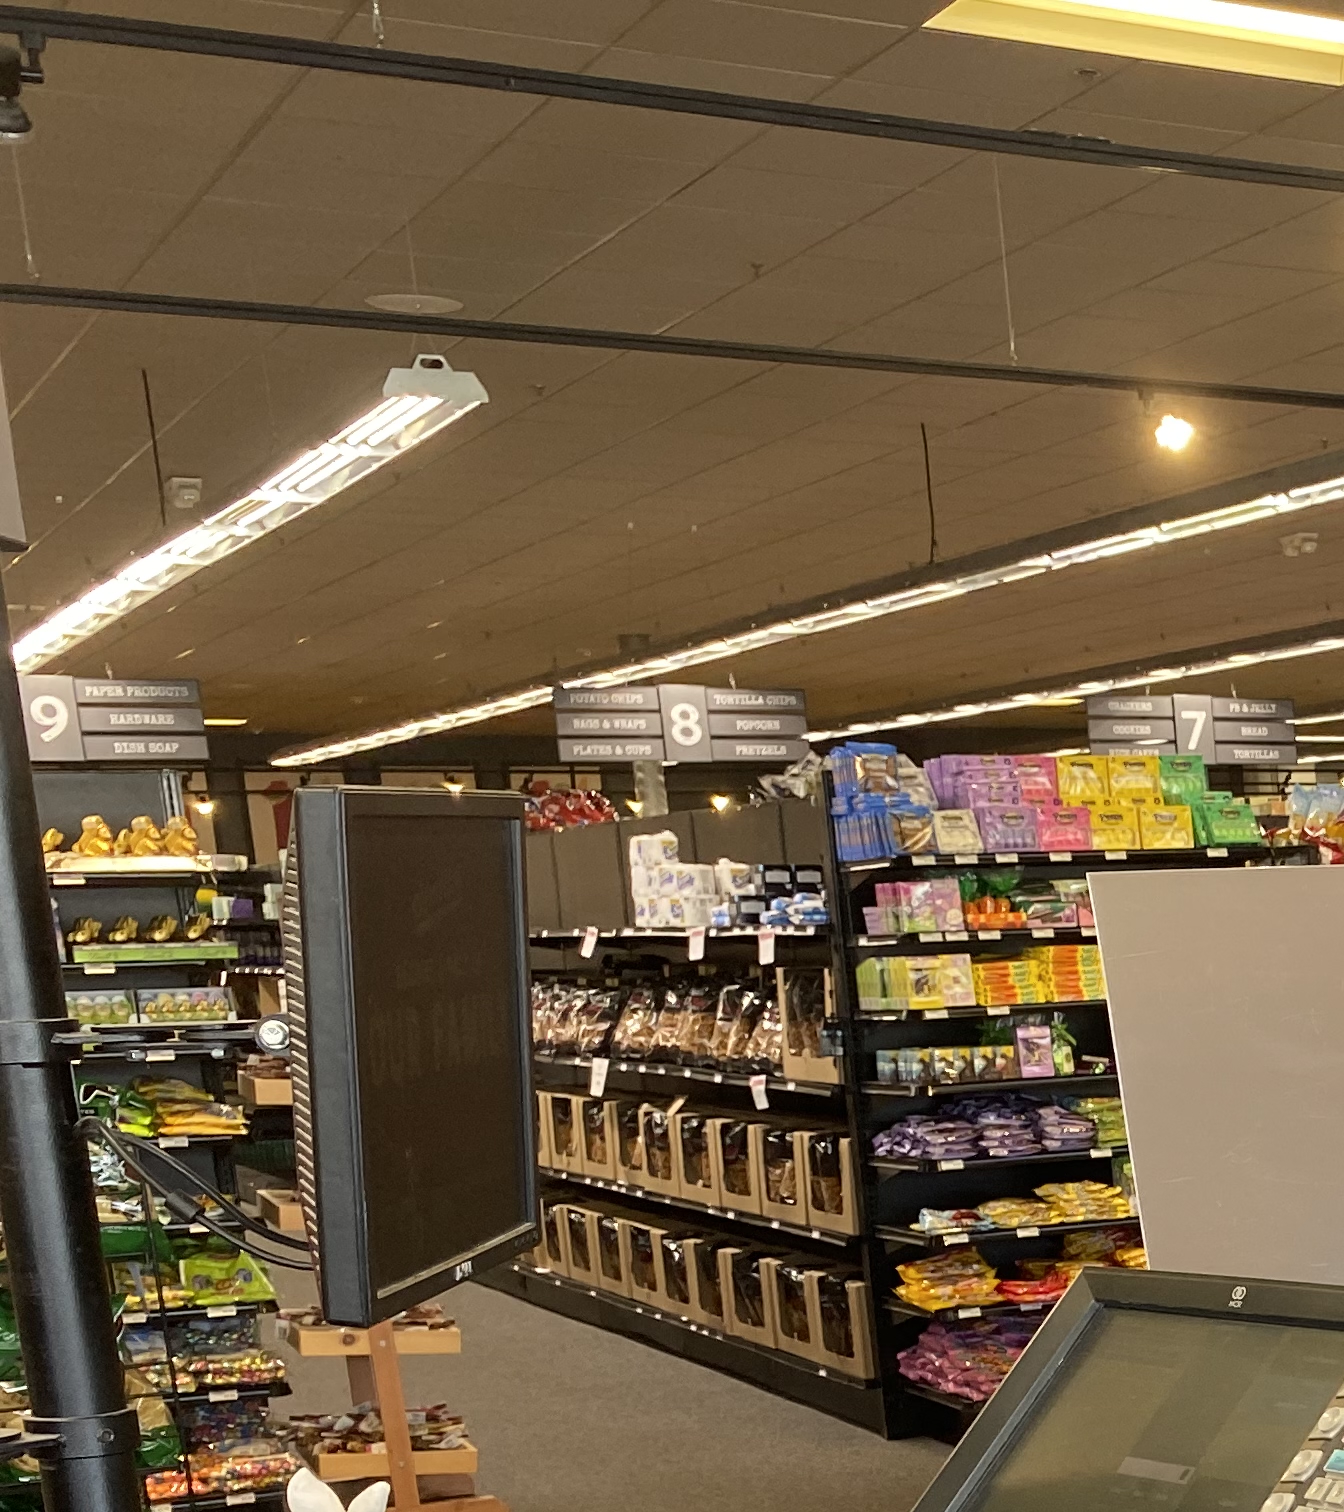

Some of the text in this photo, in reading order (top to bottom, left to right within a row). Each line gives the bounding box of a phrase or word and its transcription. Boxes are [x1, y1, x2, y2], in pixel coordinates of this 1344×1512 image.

[85, 686, 189, 697] PAPER PRODUCTS
[570, 694, 644, 704] POTATO CHIPS
[713, 694, 764, 705] TORTILLA
[30, 695, 69, 742] 9
[109, 714, 175, 725] HARDWARE
[670, 703, 702, 746] 8
[1180, 711, 1206, 750] 7
[113, 742, 180, 754] DISH SOAP
[573, 745, 612, 756] PLATES
[735, 745, 787, 756] PRETZELS
[1233, 750, 1280, 759] TORTILLAS
